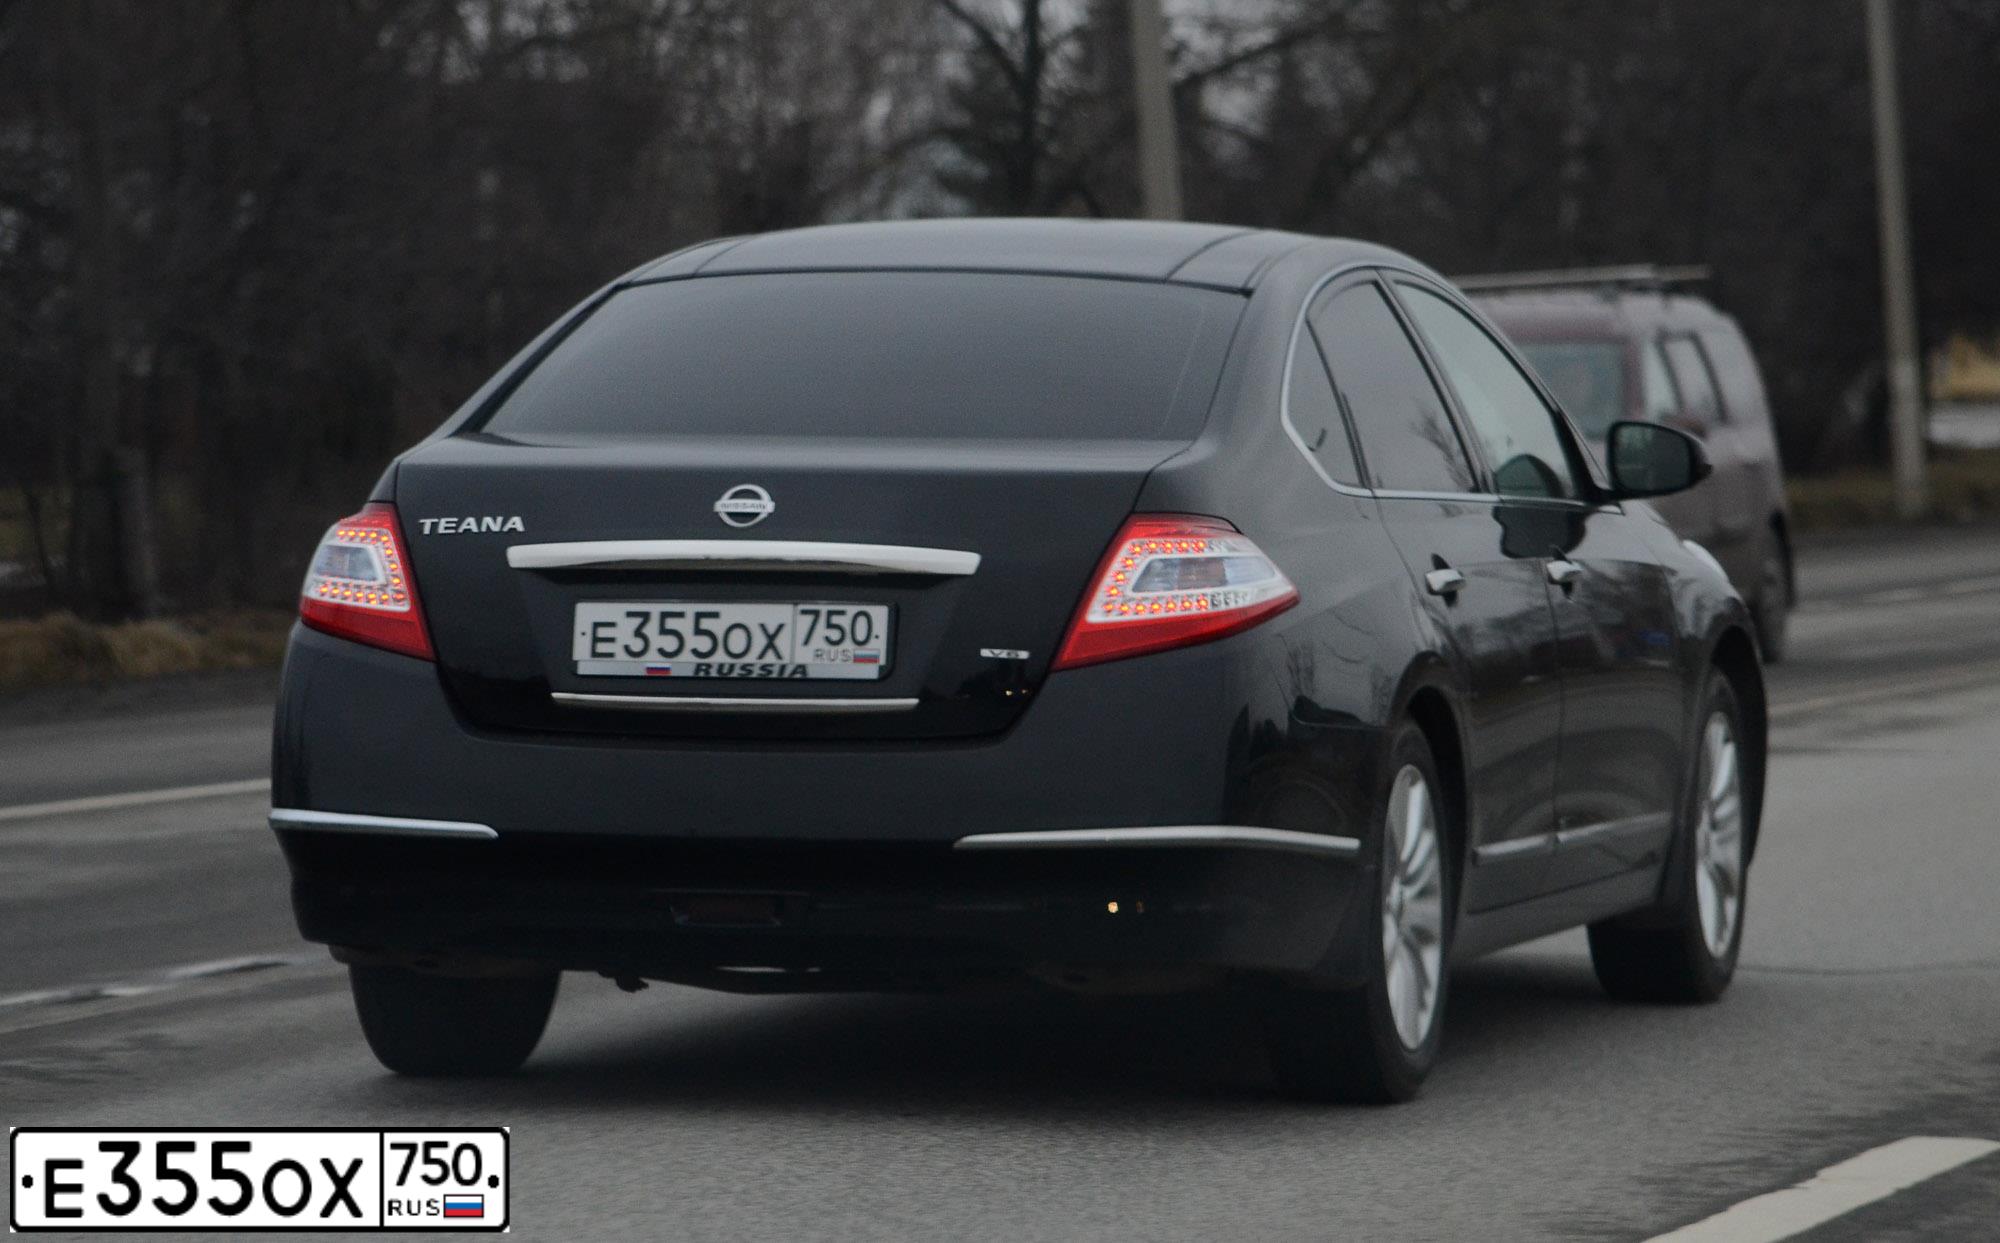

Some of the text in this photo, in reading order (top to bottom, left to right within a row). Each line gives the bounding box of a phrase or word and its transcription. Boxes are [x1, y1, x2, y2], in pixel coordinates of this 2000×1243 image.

[418, 516, 525, 535] TEANA
[591, 609, 873, 660] E355OX 750
[813, 649, 851, 663] RUS
[693, 662, 808, 678] RUSSIA
